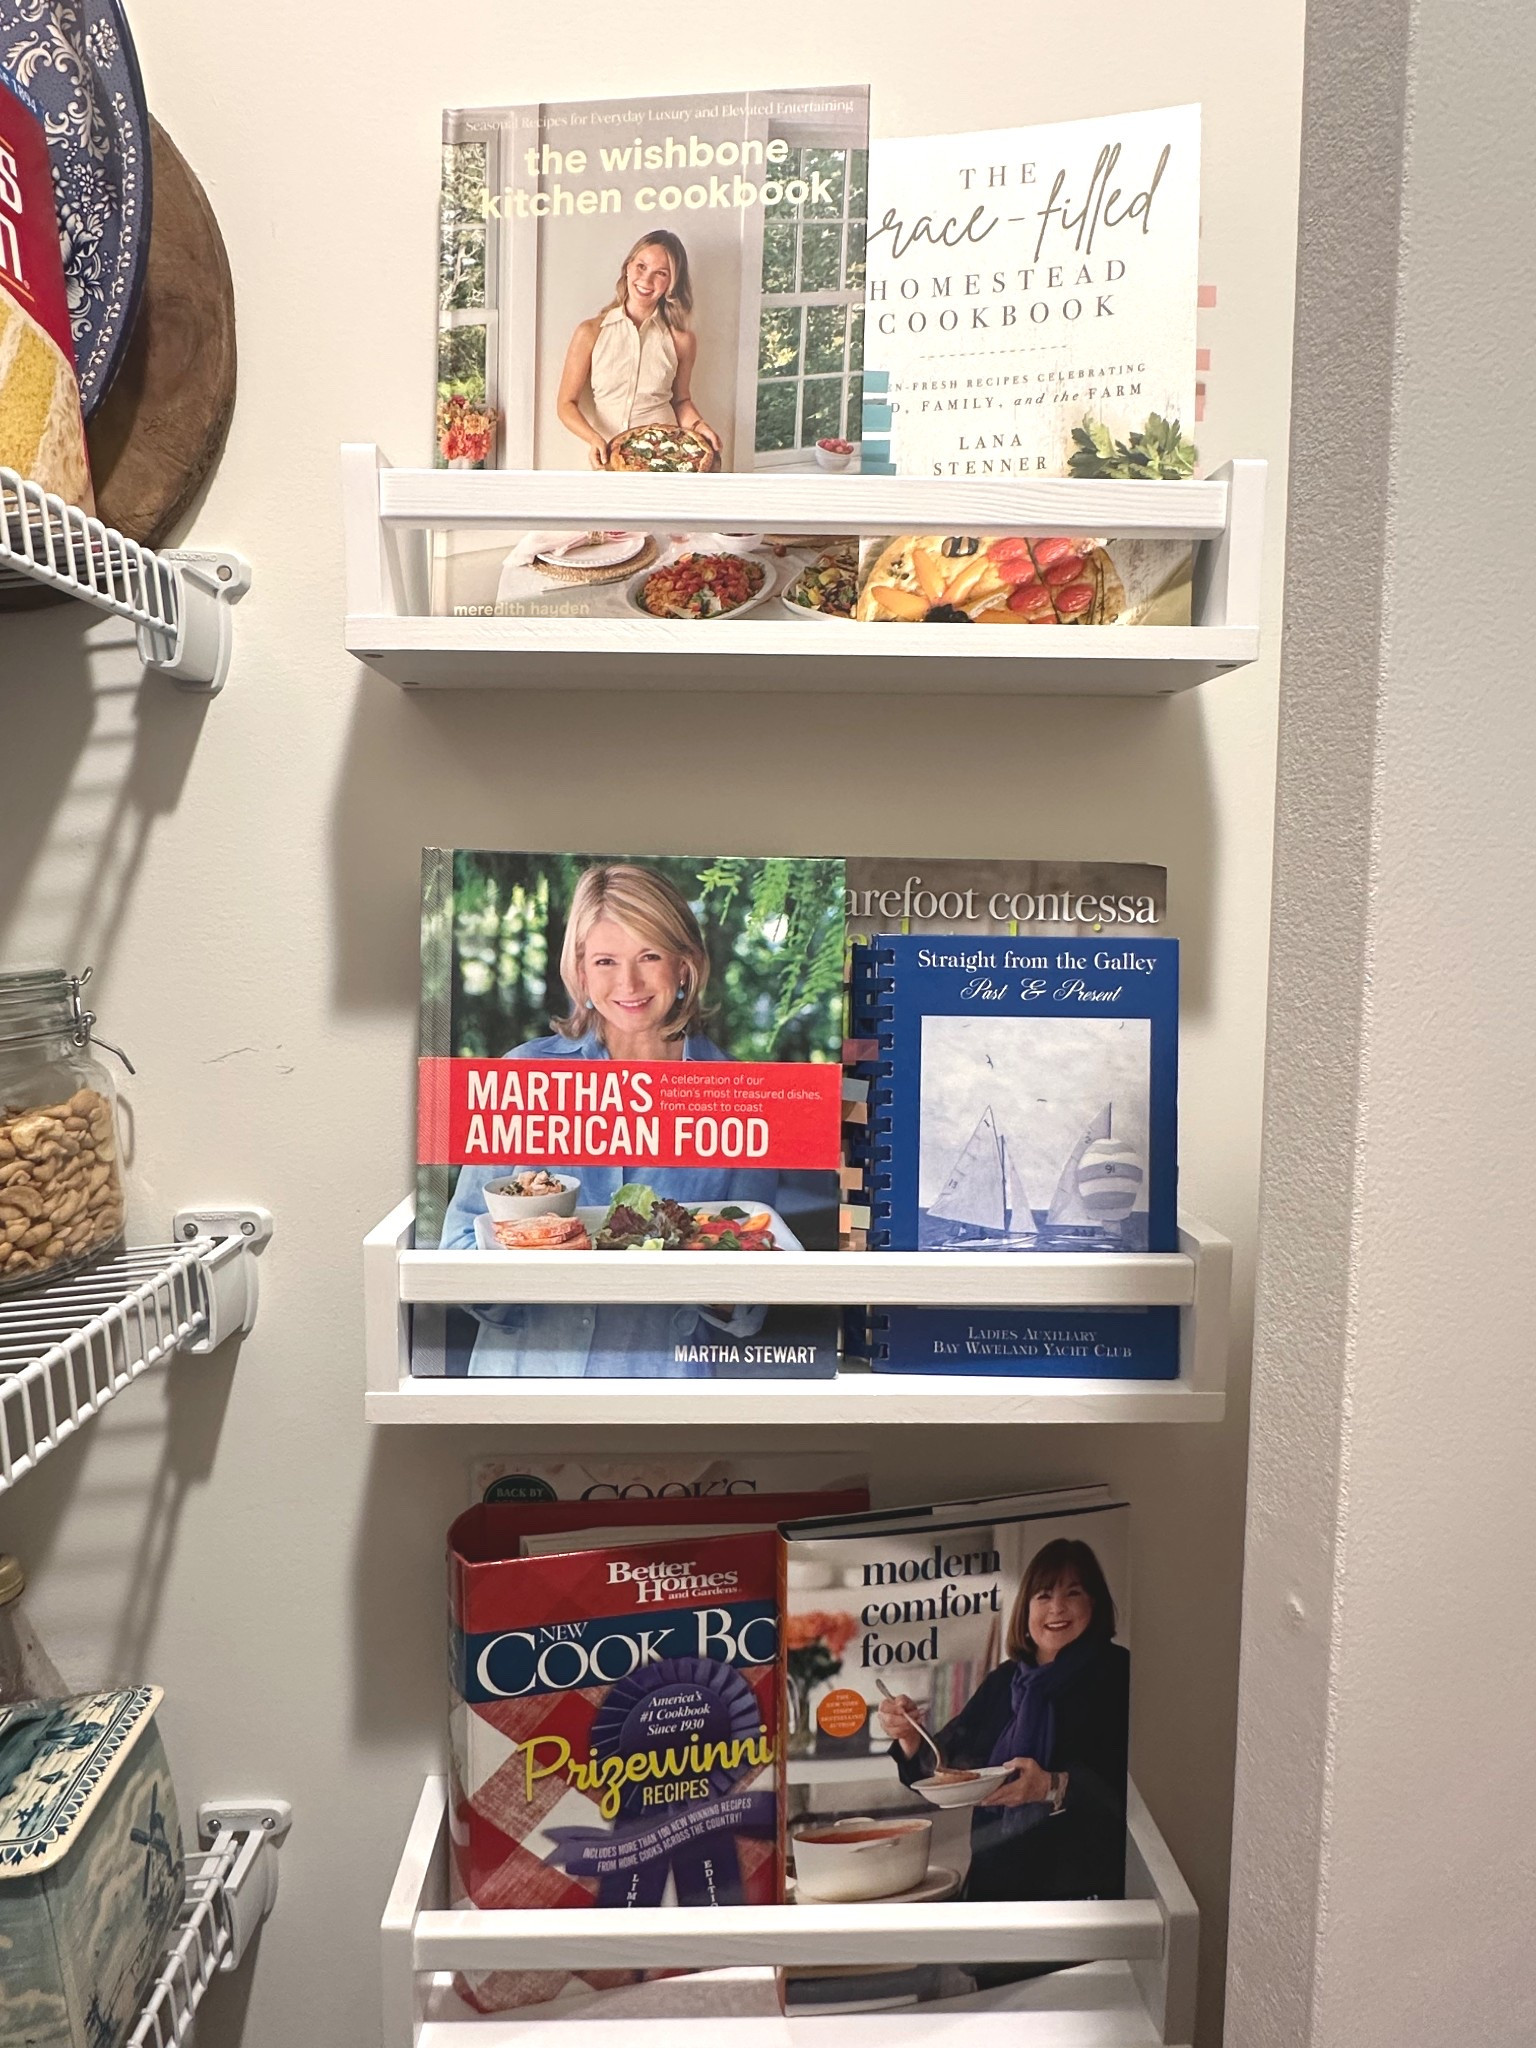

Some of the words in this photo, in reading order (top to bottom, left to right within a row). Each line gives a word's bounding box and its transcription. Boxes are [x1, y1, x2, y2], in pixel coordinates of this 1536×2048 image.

[522, 115, 567, 129] Recipes
[570, 114, 588, 126] for
[591, 110, 647, 126] Everyday
[648, 109, 690, 123] Luxury
[695, 105, 719, 118] and
[722, 101, 774, 116] Elevated
[776, 99, 854, 115] Entertaining
[524, 143, 587, 176] the
[600, 135, 789, 173] wishbone
[959, 161, 1037, 190] THE
[481, 183, 622, 219] kitchen
[634, 170, 833, 212] cookbook
[869, 259, 1127, 301] HOMESTEAD
[878, 294, 1116, 335] COOKBOOK
[966, 374, 1029, 388] RECIPES
[1037, 362, 1147, 384] CELEBRATING
[1013, 392, 1046, 407] and
[1053, 389, 1080, 403] the
[1088, 382, 1143, 400] FARM
[959, 432, 1023, 451] LANA
[933, 456, 1048, 477] STENNER
[453, 600, 525, 617] meredith
[530, 601, 591, 617] hayden
[988, 886, 1160, 924] contessa
[917, 949, 998, 973] Straight
[1003, 950, 1049, 969] from
[1055, 950, 1087, 970] the
[1094, 951, 1158, 975] Galley
[960, 977, 1010, 1001] Past
[1020, 977, 1047, 1002] &
[1052, 978, 1124, 1002] Present
[467, 1069, 654, 1114] MARTHA'S
[660, 1074, 669, 1084] A
[671, 1074, 731, 1086] celebration
[733, 1074, 745, 1086] of
[746, 1077, 765, 1086] our
[660, 1087, 700, 1098] nation's
[702, 1089, 731, 1099] most
[733, 1088, 784, 1100] treasured
[660, 1100, 686, 1111] from
[687, 1102, 718, 1112] coast
[720, 1102, 732, 1112] to
[733, 1103, 763, 1113] coast
[464, 1113, 660, 1156] AMERICAN
[674, 1116, 769, 1158] FOOD
[968, 1326, 1019, 1341] LADIES
[1022, 1327, 1098, 1343] AUXILIARY
[674, 1344, 740, 1363] MARTHA
[744, 1345, 818, 1365] STEWART
[933, 1340, 961, 1355] BAY
[966, 1342, 1038, 1356] WAVELAND
[1043, 1342, 1088, 1358] YACHT
[1094, 1343, 1133, 1358] CLUB
[496, 1487, 526, 1498] BACK
[529, 1487, 545, 1498] BY
[606, 1560, 697, 1586] Better
[861, 1545, 1001, 1587] modern
[635, 1571, 738, 1604] Homes
[668, 1590, 690, 1601] and
[691, 1585, 738, 1599] Gardens
[860, 1582, 1001, 1628] comfort
[539, 1621, 590, 1644] NEW
[860, 1626, 939, 1669] food
[647, 1690, 703, 1708] America's
[639, 1710, 654, 1724] #1
[656, 1703, 711, 1721] Cookbook
[646, 1723, 677, 1737] Since
[679, 1718, 705, 1732] 1930
[642, 1778, 710, 1806] RECIPES
[618, 1838, 639, 1856] MORE
[637, 1832, 658, 1851] THAN
[671, 1817, 688, 1834] NEW
[720, 1798, 752, 1815] RECIPES
[597, 1858, 617, 1873] FROM
[618, 1854, 639, 1870] HOME
[639, 1844, 663, 1863] COOKS
[662, 1831, 691, 1852] ACROSS
[690, 1822, 705, 1839] THE
